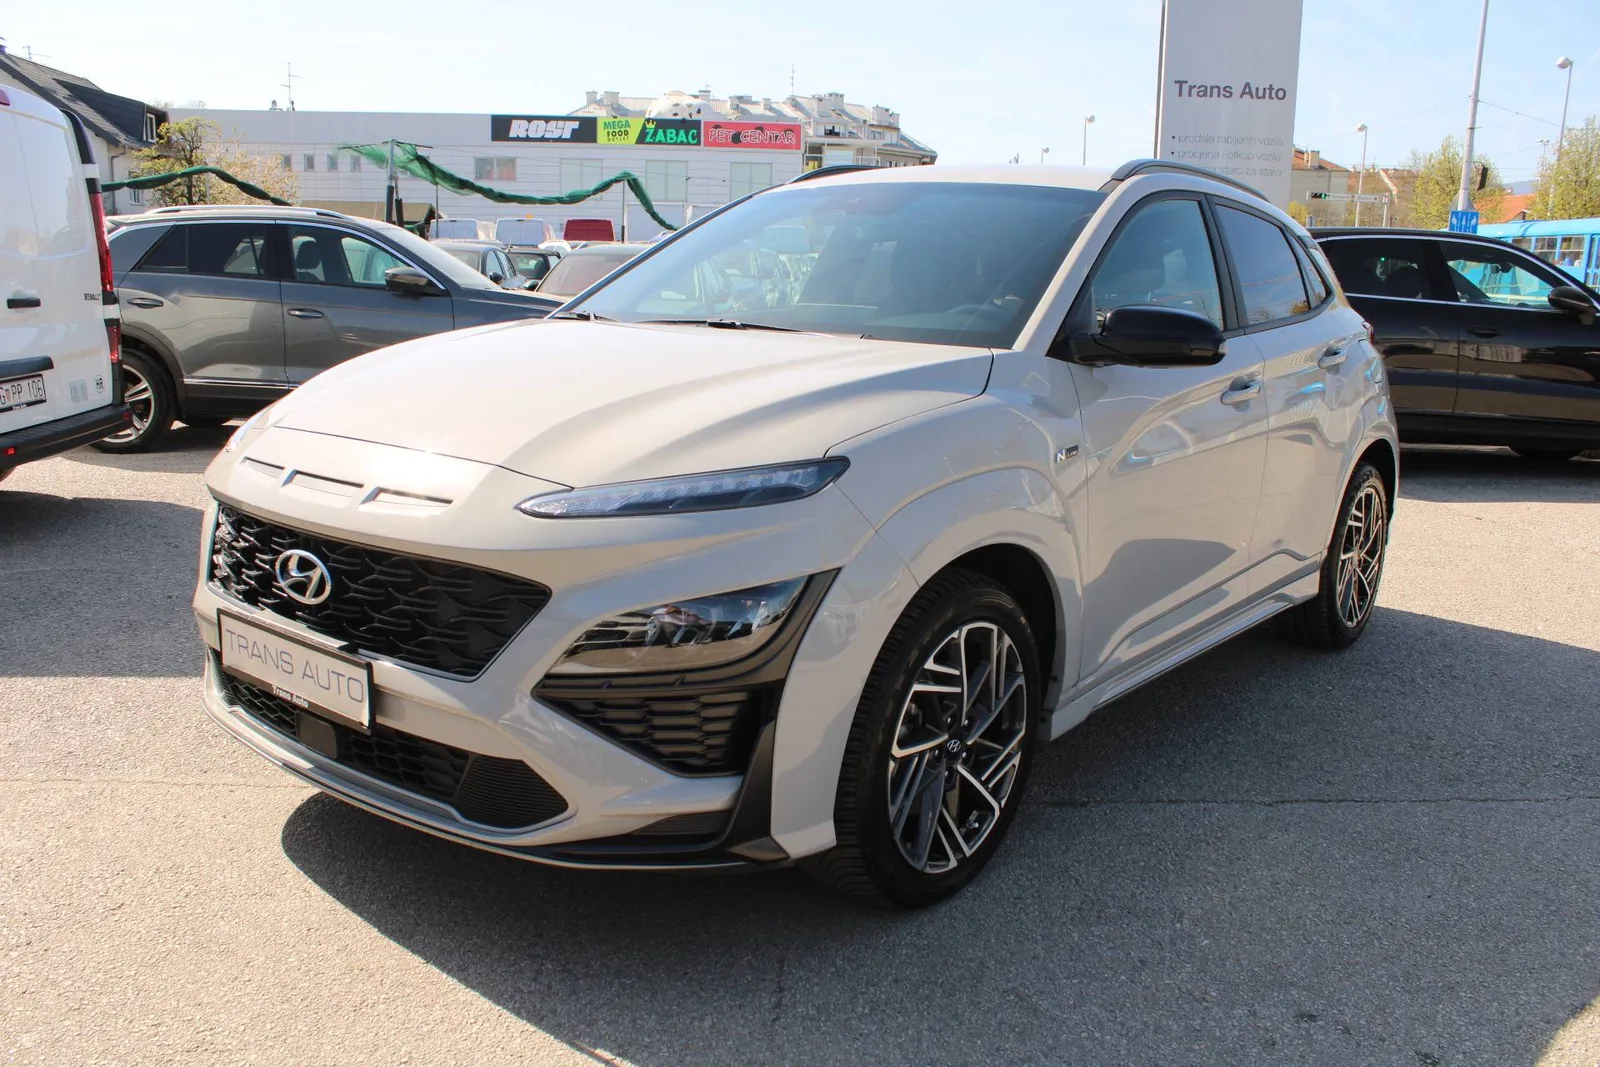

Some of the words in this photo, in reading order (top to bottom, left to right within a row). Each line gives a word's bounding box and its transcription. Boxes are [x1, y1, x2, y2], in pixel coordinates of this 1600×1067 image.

[1174, 80, 1233, 98] Trans
[1239, 82, 1287, 101] Auto
[508, 119, 580, 139] ROST
[603, 120, 631, 130] MEGA
[607, 129, 629, 138] FOOD
[708, 129, 735, 143] PET
[740, 130, 795, 145] CENTAR
[1178, 133, 1214, 145] prodaja
[1259, 136, 1284, 147] vozila
[1177, 149, 1219, 160] procjena
[1227, 151, 1254, 162] otkup
[1257, 152, 1281, 162] vozila
[1245, 168, 1257, 177] za
[1258, 168, 1282, 177] staro
[11, 383, 22, 401] PP
[28, 379, 44, 399] 106
[225, 629, 294, 676] TRANS
[301, 660, 364, 704] AUTO
[271, 685, 292, 702] Trans
[293, 694, 309, 709] Auto
